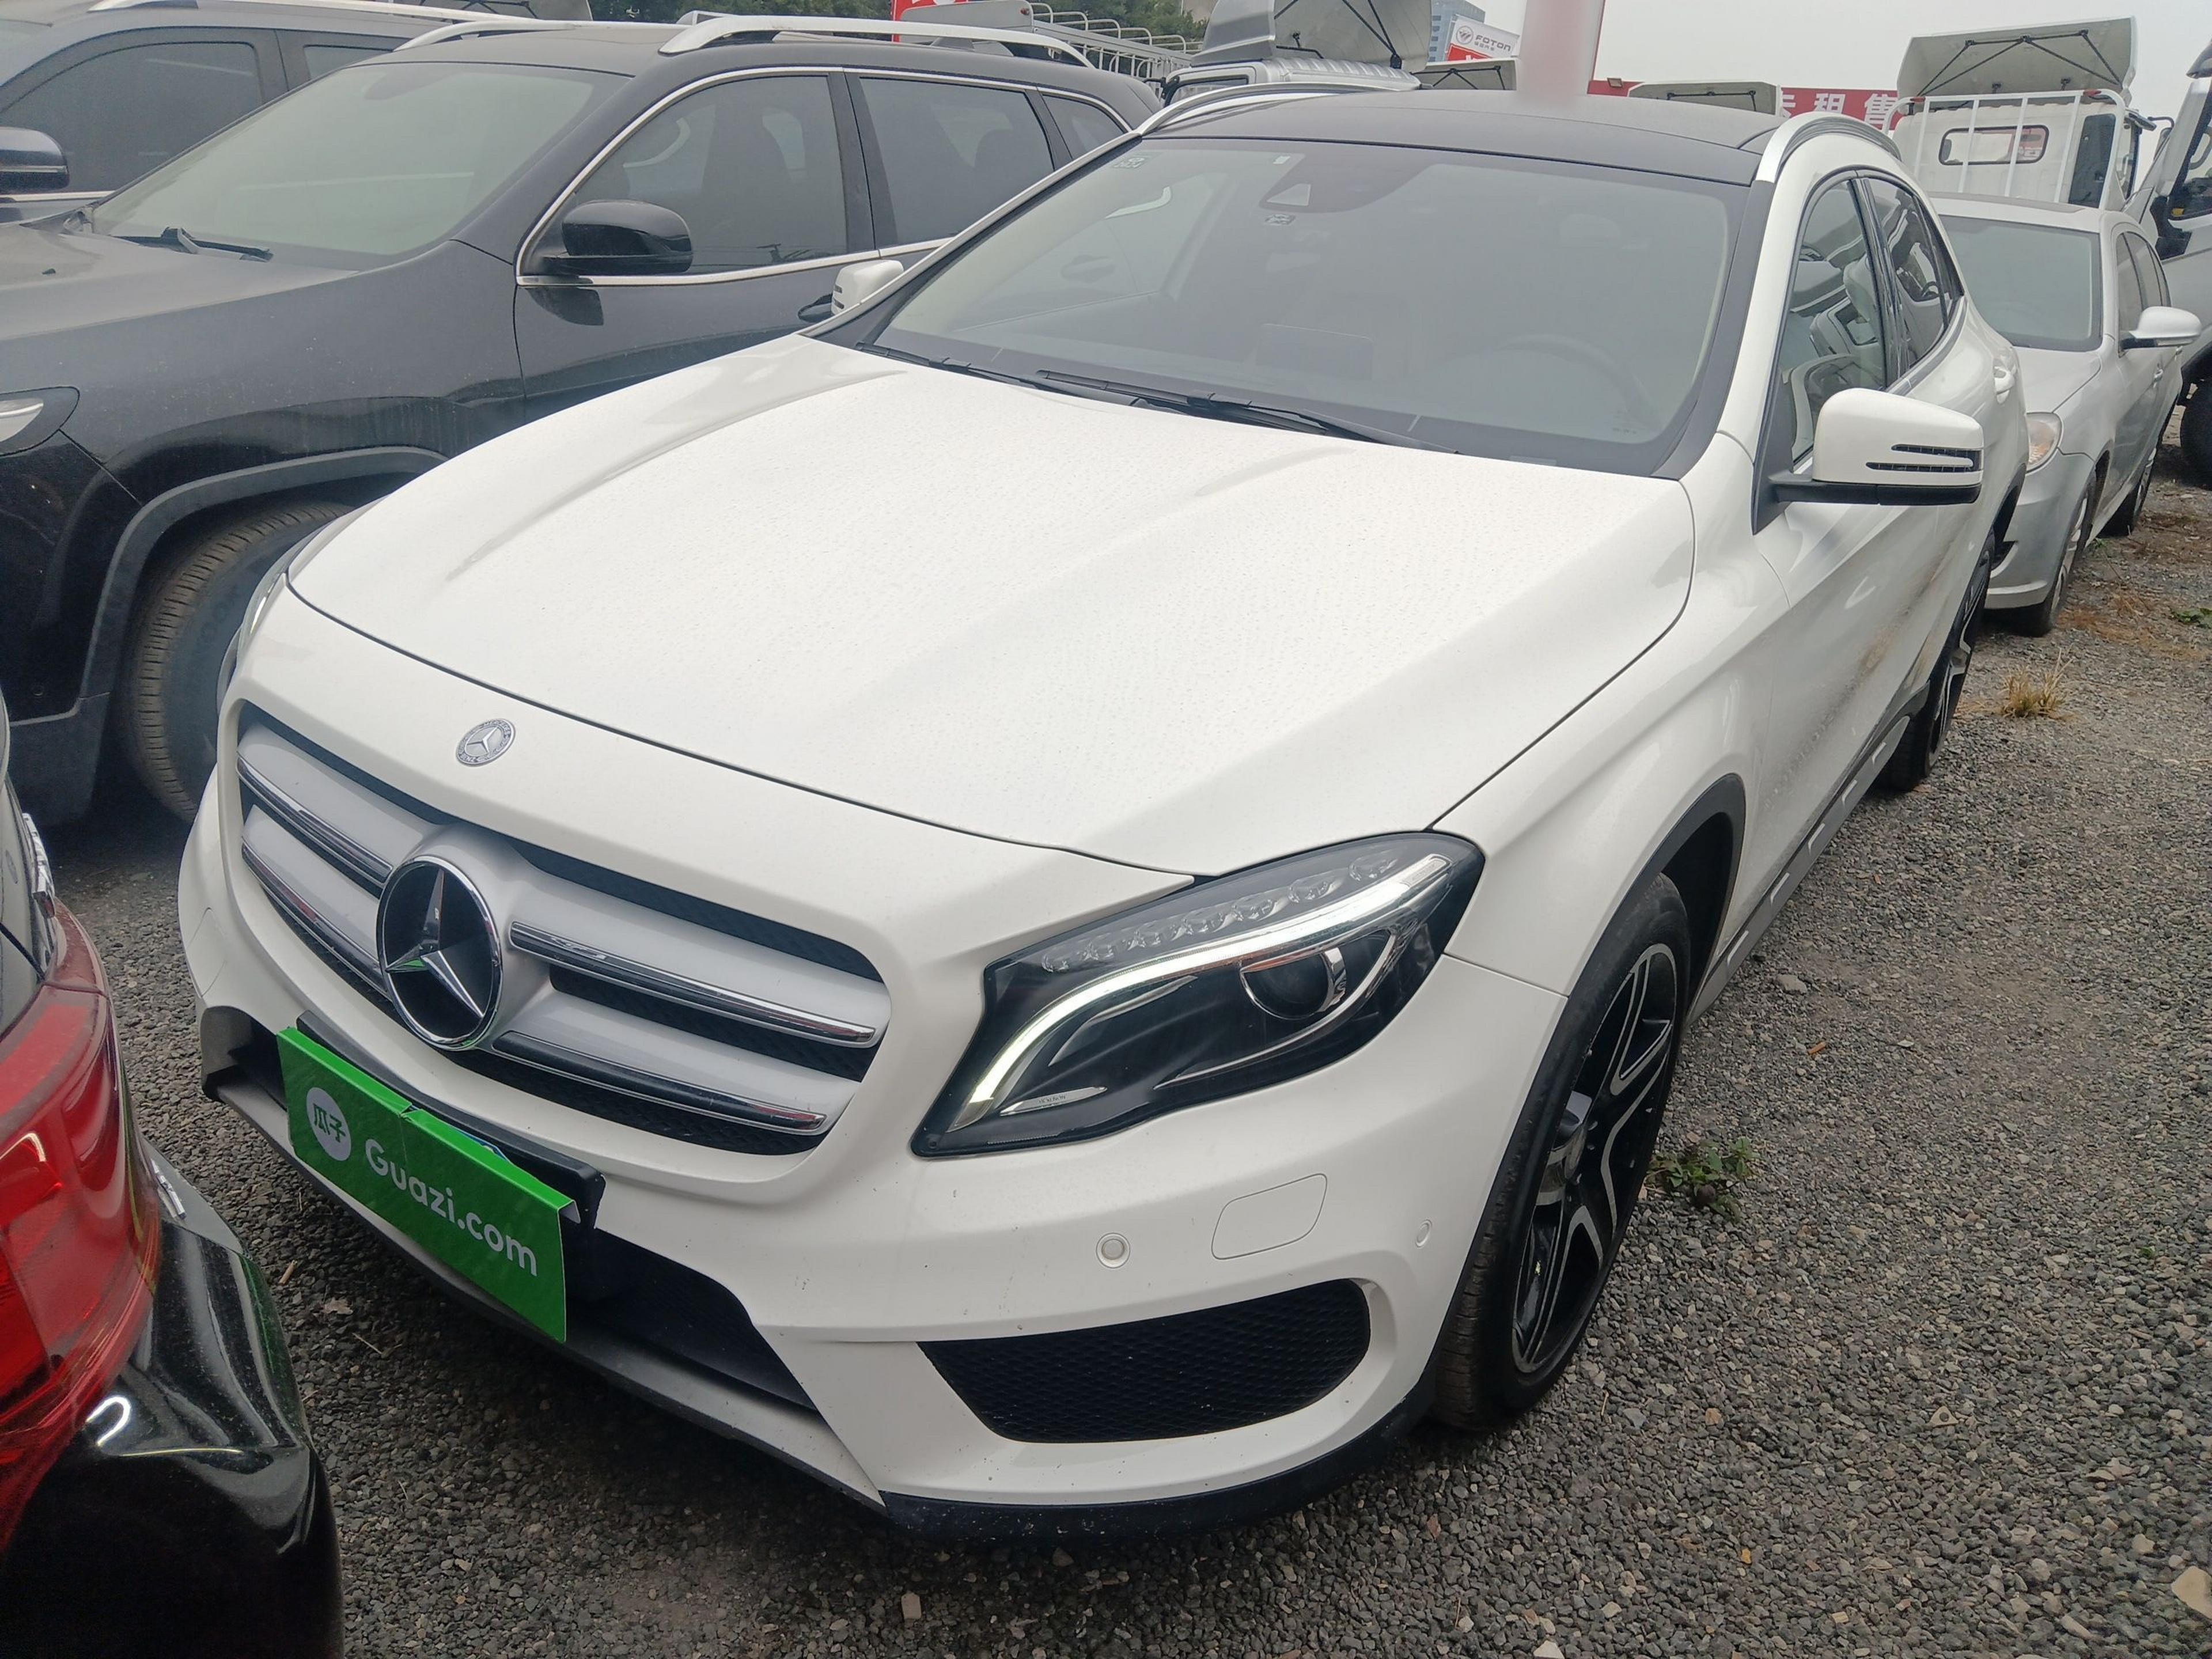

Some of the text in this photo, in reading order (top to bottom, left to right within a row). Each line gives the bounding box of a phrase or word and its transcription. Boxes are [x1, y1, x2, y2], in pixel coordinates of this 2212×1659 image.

[1476, 35, 1511, 51] FOTON
[312, 1104, 346, 1143] 瓜子
[365, 1139, 537, 1277] Guazi.com
